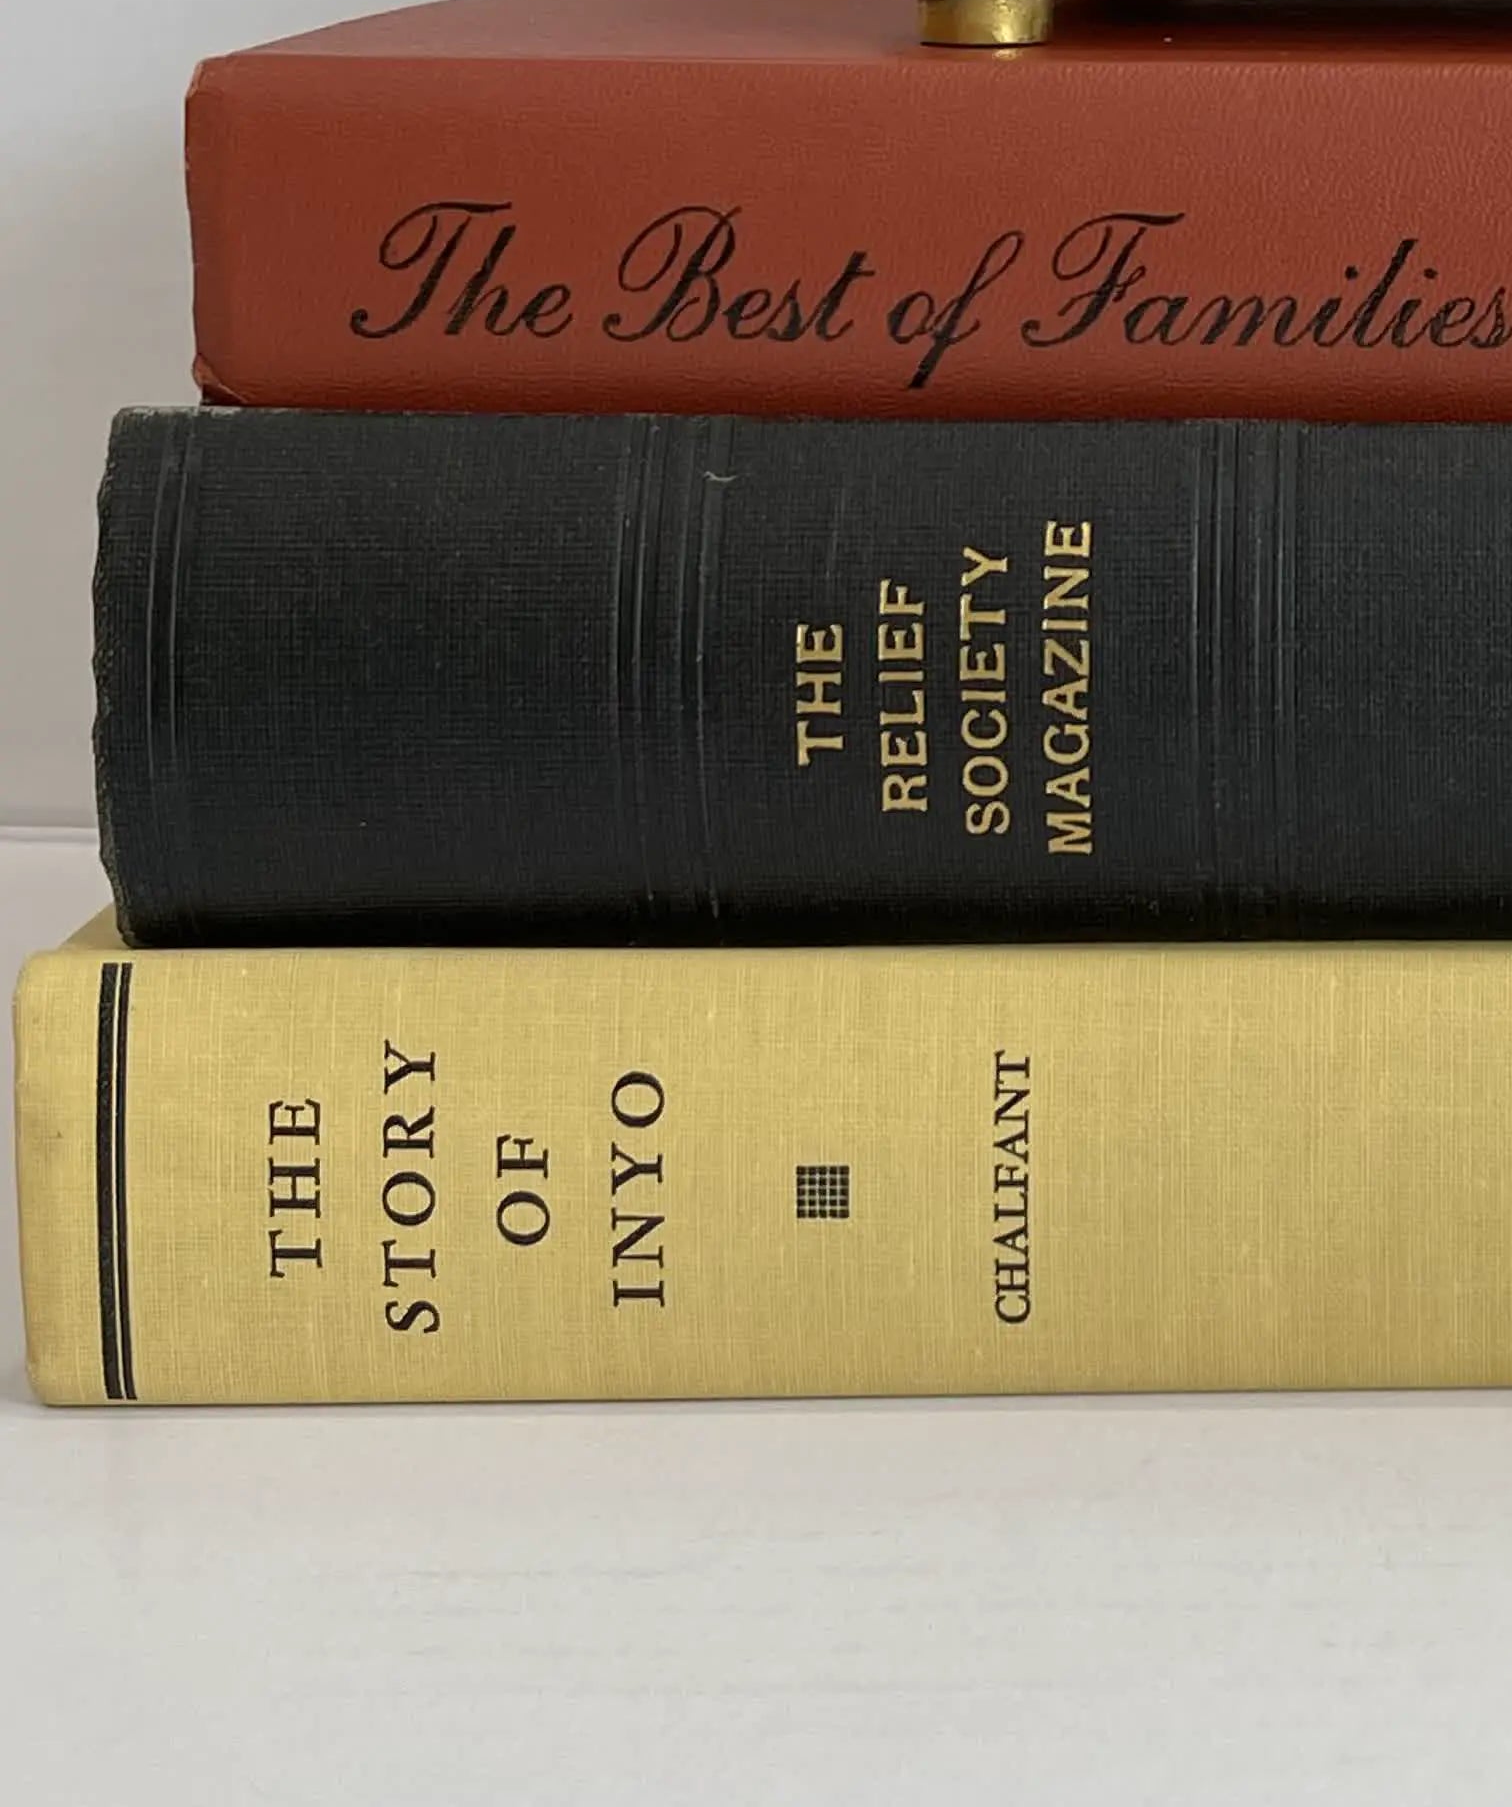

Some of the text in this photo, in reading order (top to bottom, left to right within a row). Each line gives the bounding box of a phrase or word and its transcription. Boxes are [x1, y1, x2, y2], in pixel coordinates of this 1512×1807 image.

[349, 200, 573, 341] The
[602, 205, 876, 343] Best
[887, 229, 1024, 391] of
[796, 624, 843, 766] THE
[878, 579, 928, 812] RELIEF
[960, 547, 1010, 834] SOCIETY
[1042, 521, 1093, 855] MAGAZINE
[269, 1099, 322, 1278] THE
[382, 1039, 440, 1334] STORY
[496, 1134, 549, 1246] OF
[611, 1070, 665, 1308] INYO
[993, 1049, 1031, 1325] CHALFANT
